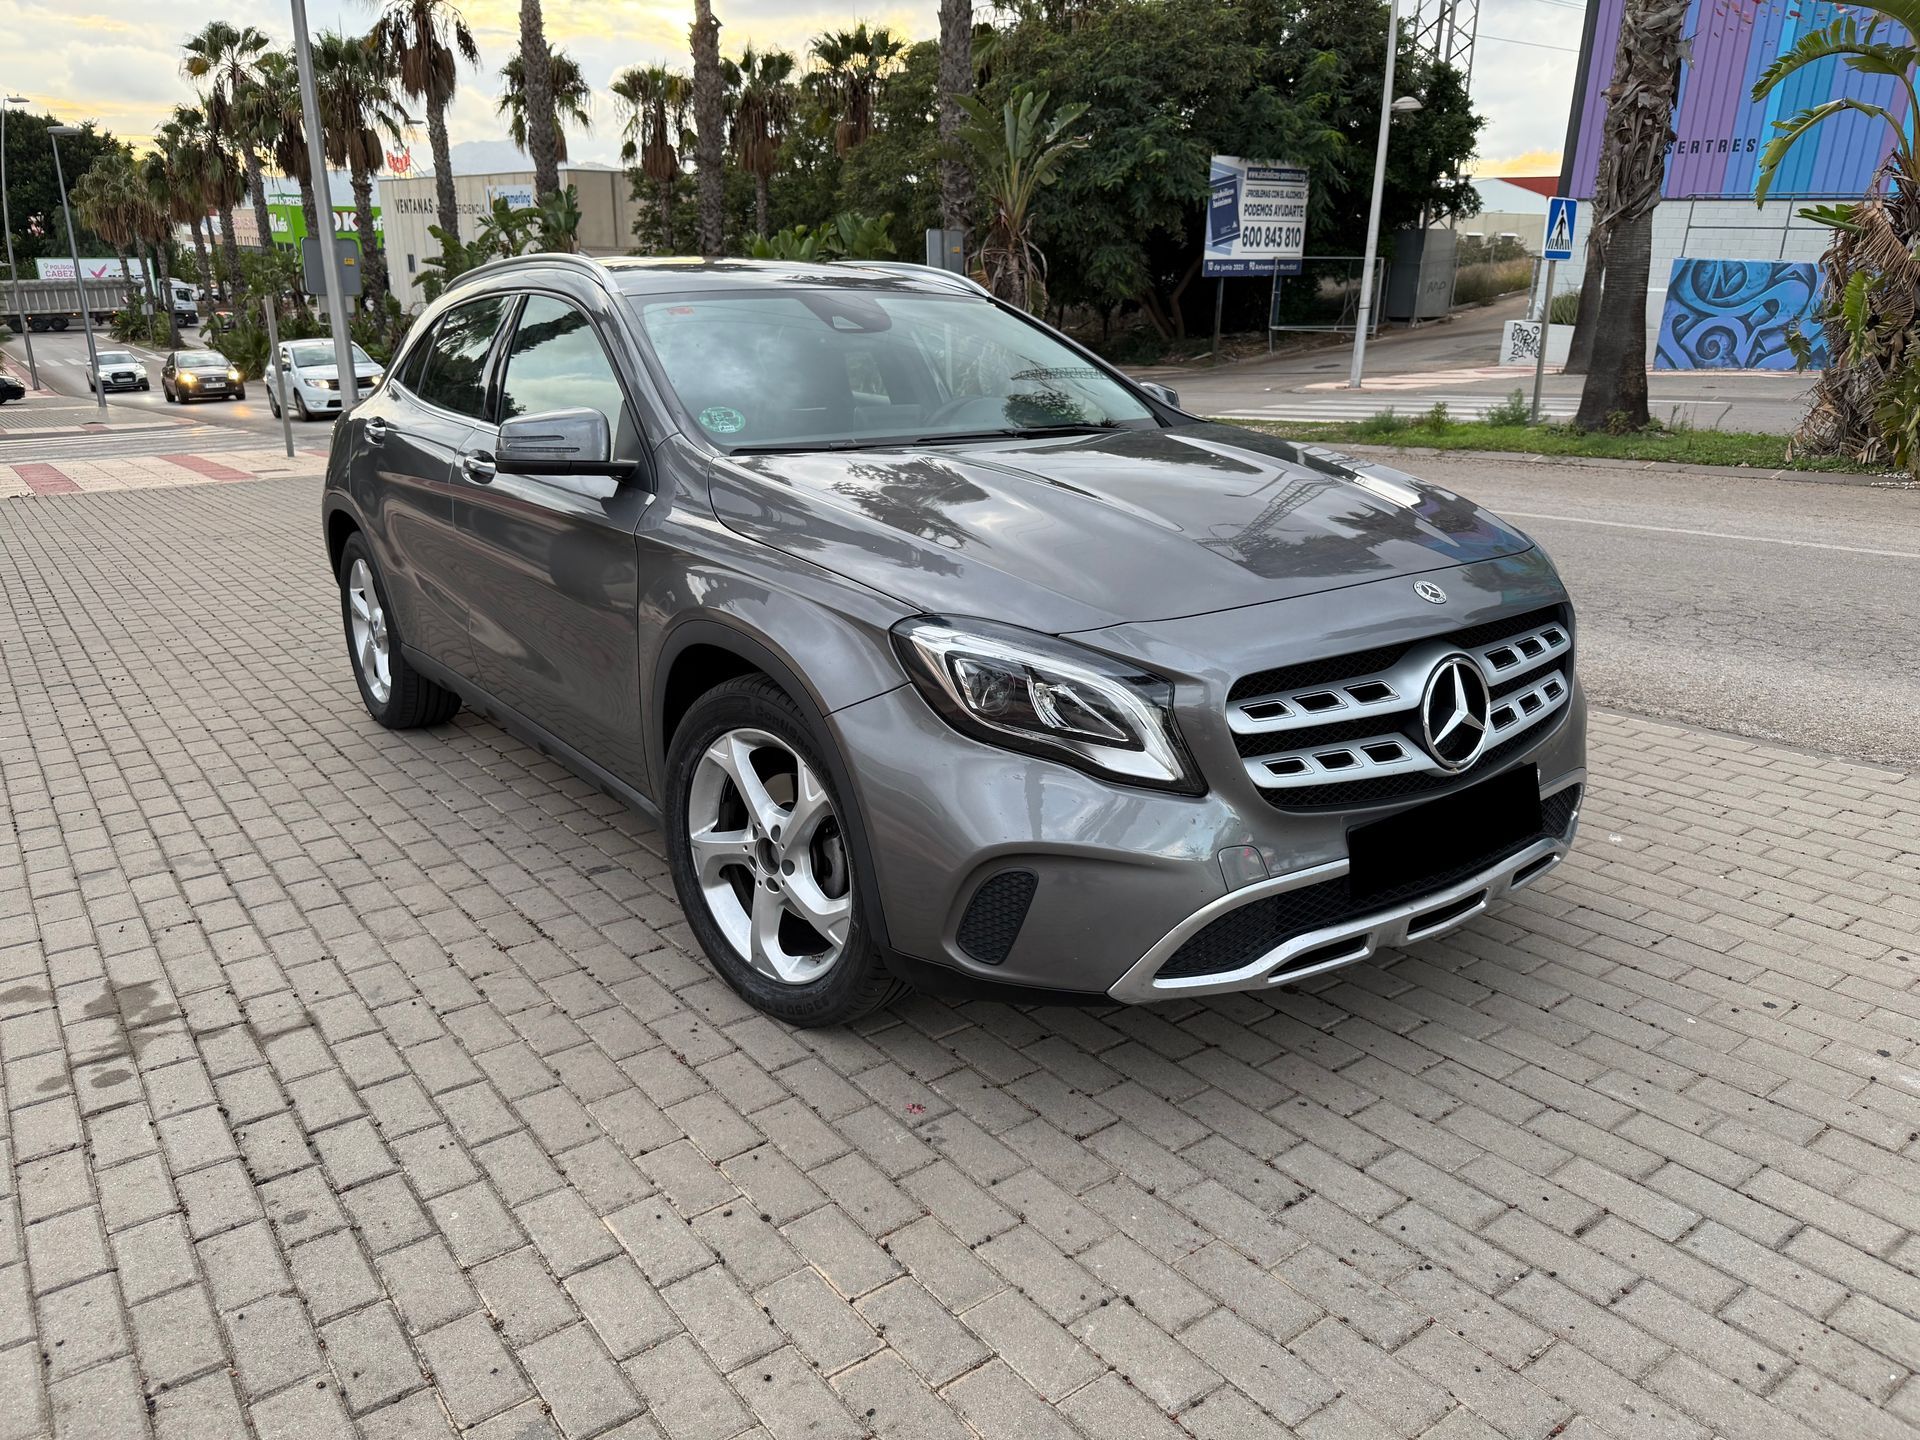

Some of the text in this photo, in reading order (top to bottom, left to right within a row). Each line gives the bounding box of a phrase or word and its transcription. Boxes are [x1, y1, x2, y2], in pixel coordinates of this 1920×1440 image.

[498, 191, 531, 207] mmerling
[1271, 190, 1280, 199] CON
[395, 198, 433, 214] VENTANAS
[1243, 203, 1273, 217] PODEMOS
[1273, 204, 1304, 217] AYUDARTE
[1242, 226, 1262, 248] 600
[1264, 226, 1283, 248] 843
[1284, 227, 1301, 248] 810
[45, 270, 76, 278] CABEZ
[1255, 263, 1279, 271] Aniversaio
